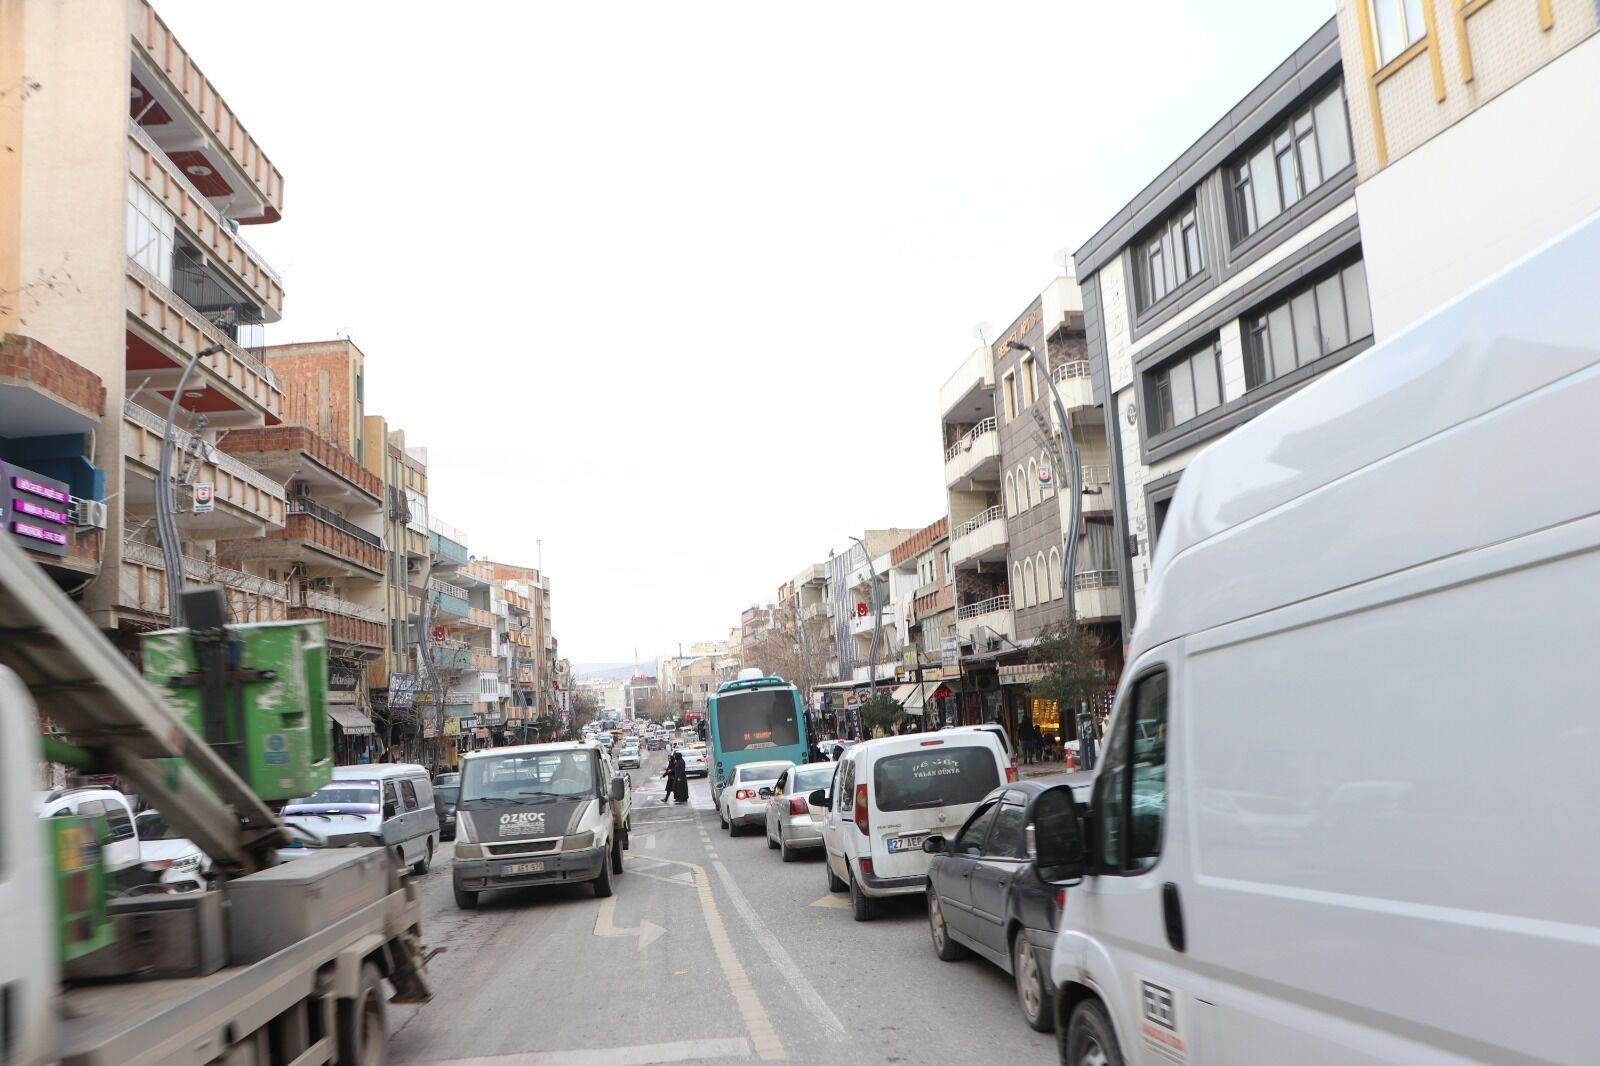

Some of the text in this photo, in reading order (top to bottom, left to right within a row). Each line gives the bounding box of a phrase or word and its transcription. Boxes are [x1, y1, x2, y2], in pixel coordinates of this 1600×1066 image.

[913, 766, 961, 778] YALAN DÜNYA
[893, 837, 922, 848] 27 AEP
